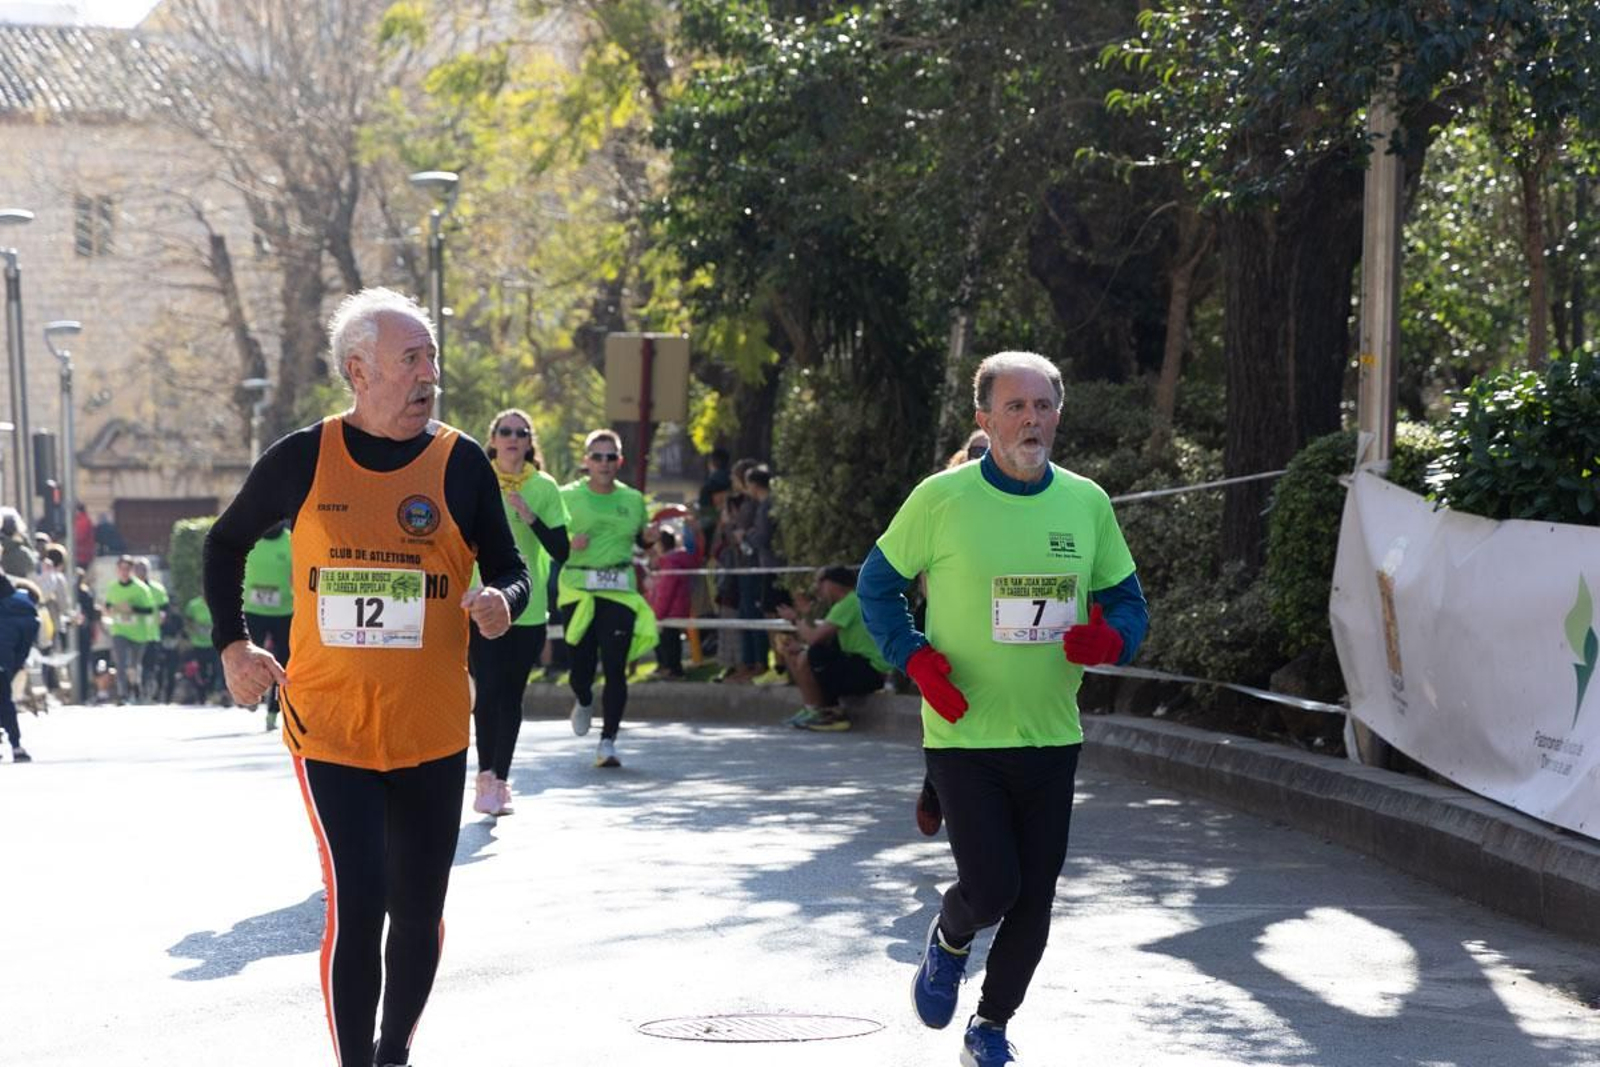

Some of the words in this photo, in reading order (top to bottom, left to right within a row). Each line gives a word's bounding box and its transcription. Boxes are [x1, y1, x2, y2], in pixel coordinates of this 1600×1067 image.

[330, 547, 352, 559] CLUB
[355, 549, 367, 560] DE
[370, 550, 421, 565] ATLETISMO
[338, 571, 350, 581] SAN
[352, 571, 369, 582] JUAN
[372, 572, 391, 582] BOSCO
[1011, 577, 1023, 586] SAN
[1024, 577, 1040, 586] JUAN
[333, 582, 357, 593] CARRERA
[360, 582, 386, 593] POPULAR
[1007, 587, 1030, 597] CARRERA
[354, 597, 384, 628] 12
[1032, 599, 1047, 627] 7
